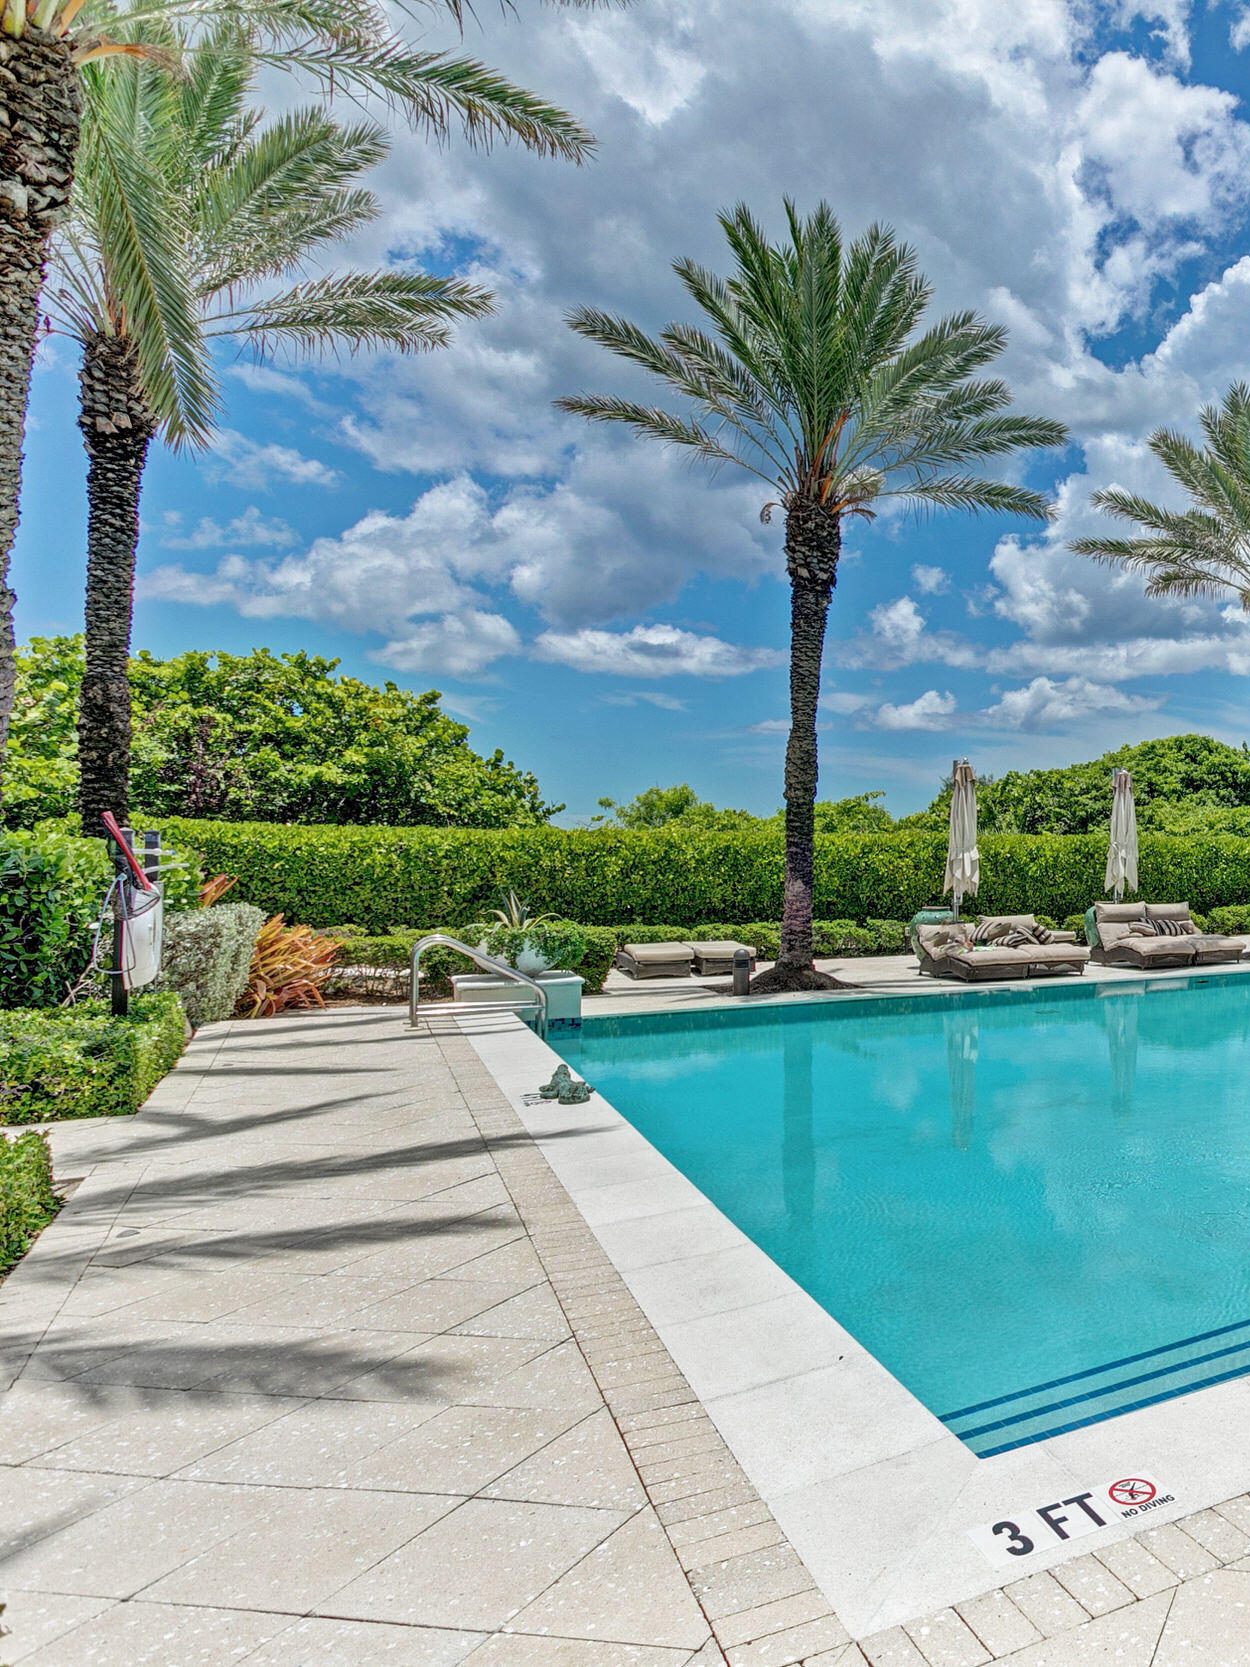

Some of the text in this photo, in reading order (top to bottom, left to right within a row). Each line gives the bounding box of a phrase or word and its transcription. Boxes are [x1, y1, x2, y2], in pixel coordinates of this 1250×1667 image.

[992, 1492, 1107, 1556] 3 FT
[1121, 1494, 1175, 1518] NO DIVING
